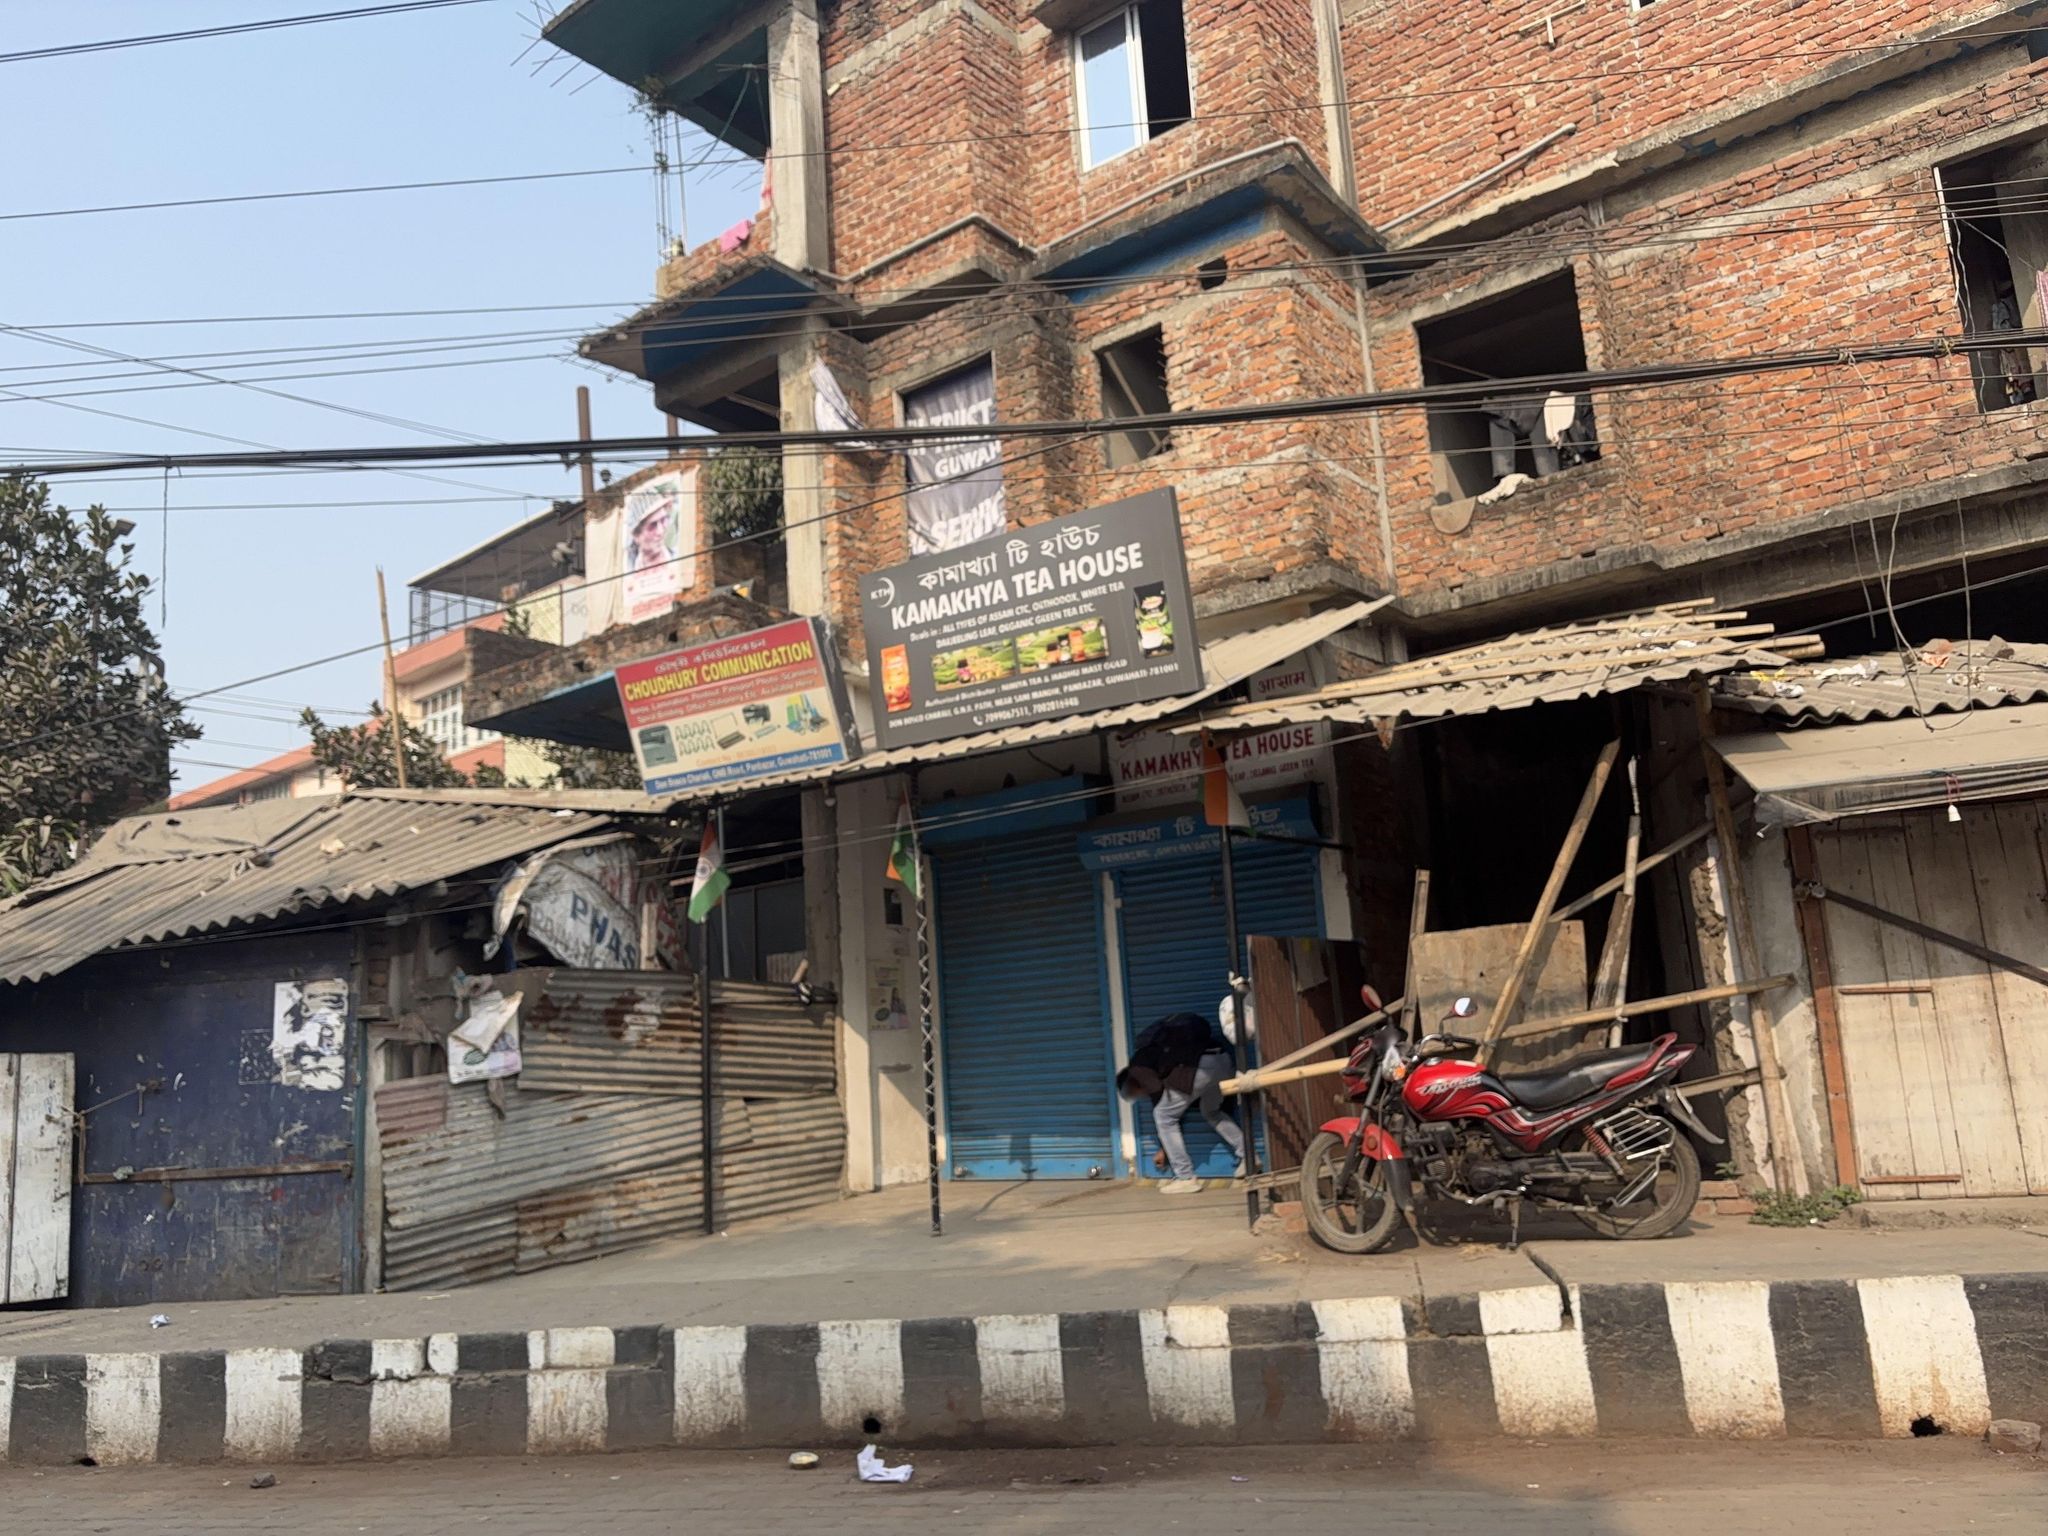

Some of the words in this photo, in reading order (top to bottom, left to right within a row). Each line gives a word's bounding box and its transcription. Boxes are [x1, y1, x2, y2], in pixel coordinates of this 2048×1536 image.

[917, 551, 998, 591] কামাখ্যা
[1005, 539, 1030, 568] টি
[1039, 524, 1101, 559] হাউচ
[870, 585, 892, 600] KTH
[891, 578, 1009, 630] KAMAKHYA
[1011, 566, 1055, 599] TEA
[1058, 542, 1144, 587] HOUSE
[942, 623, 956, 634] ALL
[955, 617, 977, 630] TYPES
[976, 614, 988, 625] OF
[988, 608, 1015, 622] ASSAM
[1080, 584, 1108, 599] WHITE
[1108, 581, 1125, 593] TEA
[998, 616, 1035, 634] ORGANIC
[1034, 610, 1062, 625] GREEN
[1062, 606, 1078, 618] TEA
[624, 668, 698, 701] CHOUDHURY
[701, 640, 813, 683] COMMUNICATION
[1028, 676, 1043, 685] TEA
[1257, 726, 1316, 756] HOUSE
